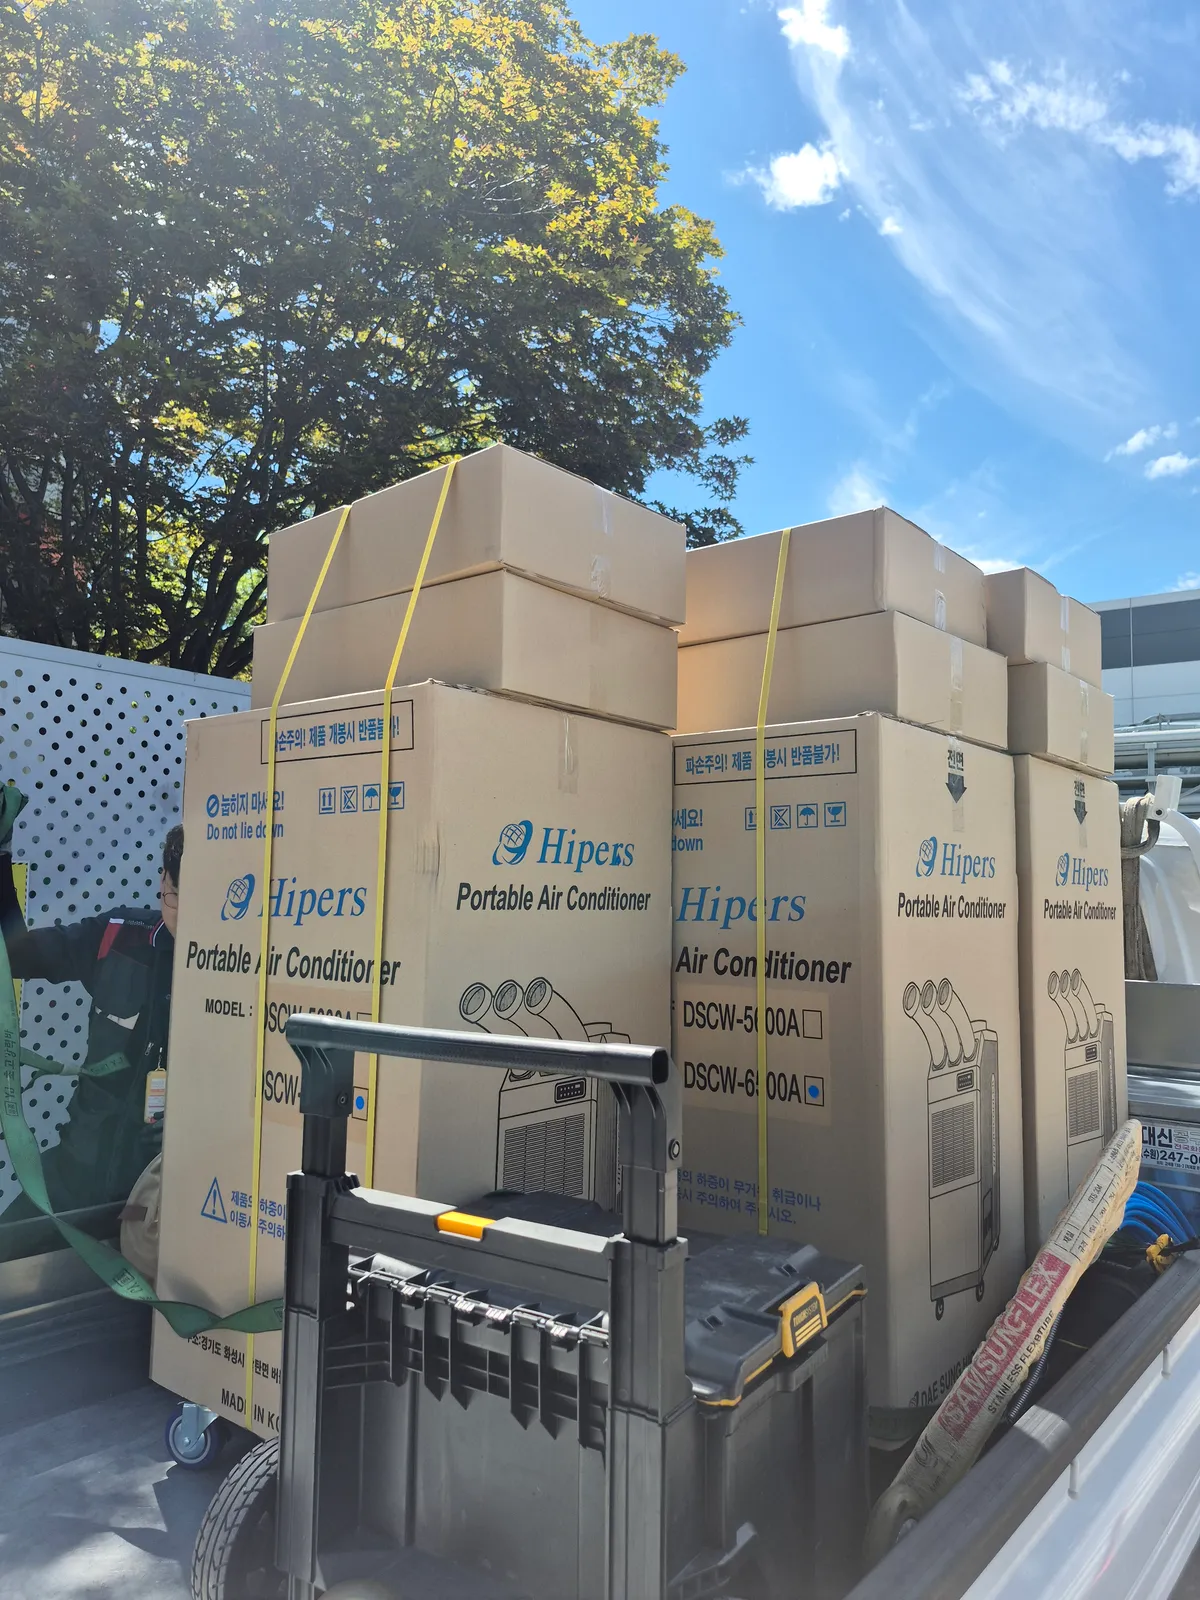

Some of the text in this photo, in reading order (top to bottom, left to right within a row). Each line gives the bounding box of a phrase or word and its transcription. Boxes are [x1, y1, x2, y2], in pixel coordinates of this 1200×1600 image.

[274, 728, 306, 752] 손주의!
[309, 725, 326, 747] 제품
[329, 720, 355, 745] 개봉시
[685, 743, 840, 775] 파손주의! 제품 봉시 반품불가!
[947, 749, 964, 771] 전면
[221, 792, 249, 816] 눕히지
[1073, 780, 1086, 798] 전면
[206, 823, 220, 840] Do
[222, 823, 238, 840] not
[240, 821, 253, 839] lie
[672, 808, 703, 830] 세요!
[537, 826, 635, 873] Hipers
[940, 842, 996, 884] Hipers
[1071, 857, 1109, 891] Hipers
[257, 876, 367, 927] Hipers
[456, 882, 651, 912] Portable Air Conditioner
[675, 885, 806, 930] Hipers
[897, 892, 1006, 919] Portable Air Conditioner
[1043, 898, 1116, 920] Portable Air Conditioner
[186, 941, 251, 974] Portable
[675, 946, 852, 984] Air Conditioner
[205, 998, 246, 1018] MODEL
[683, 1000, 800, 1038] DSCW-500A
[684, 1061, 802, 1104] DSCW-600A
[260, 1198, 286, 1220] 하중이
[696, 1191, 741, 1212] 주의하여
[745, 1202, 797, 1224] 주시오.
[772, 1187, 821, 1211] 취급이나
[224, 1345, 245, 1368] 화성시
[253, 1358, 269, 1379] 탄면
[987, 1363, 1023, 1414] STAINLESS
[253, 1404, 265, 1424] IN
